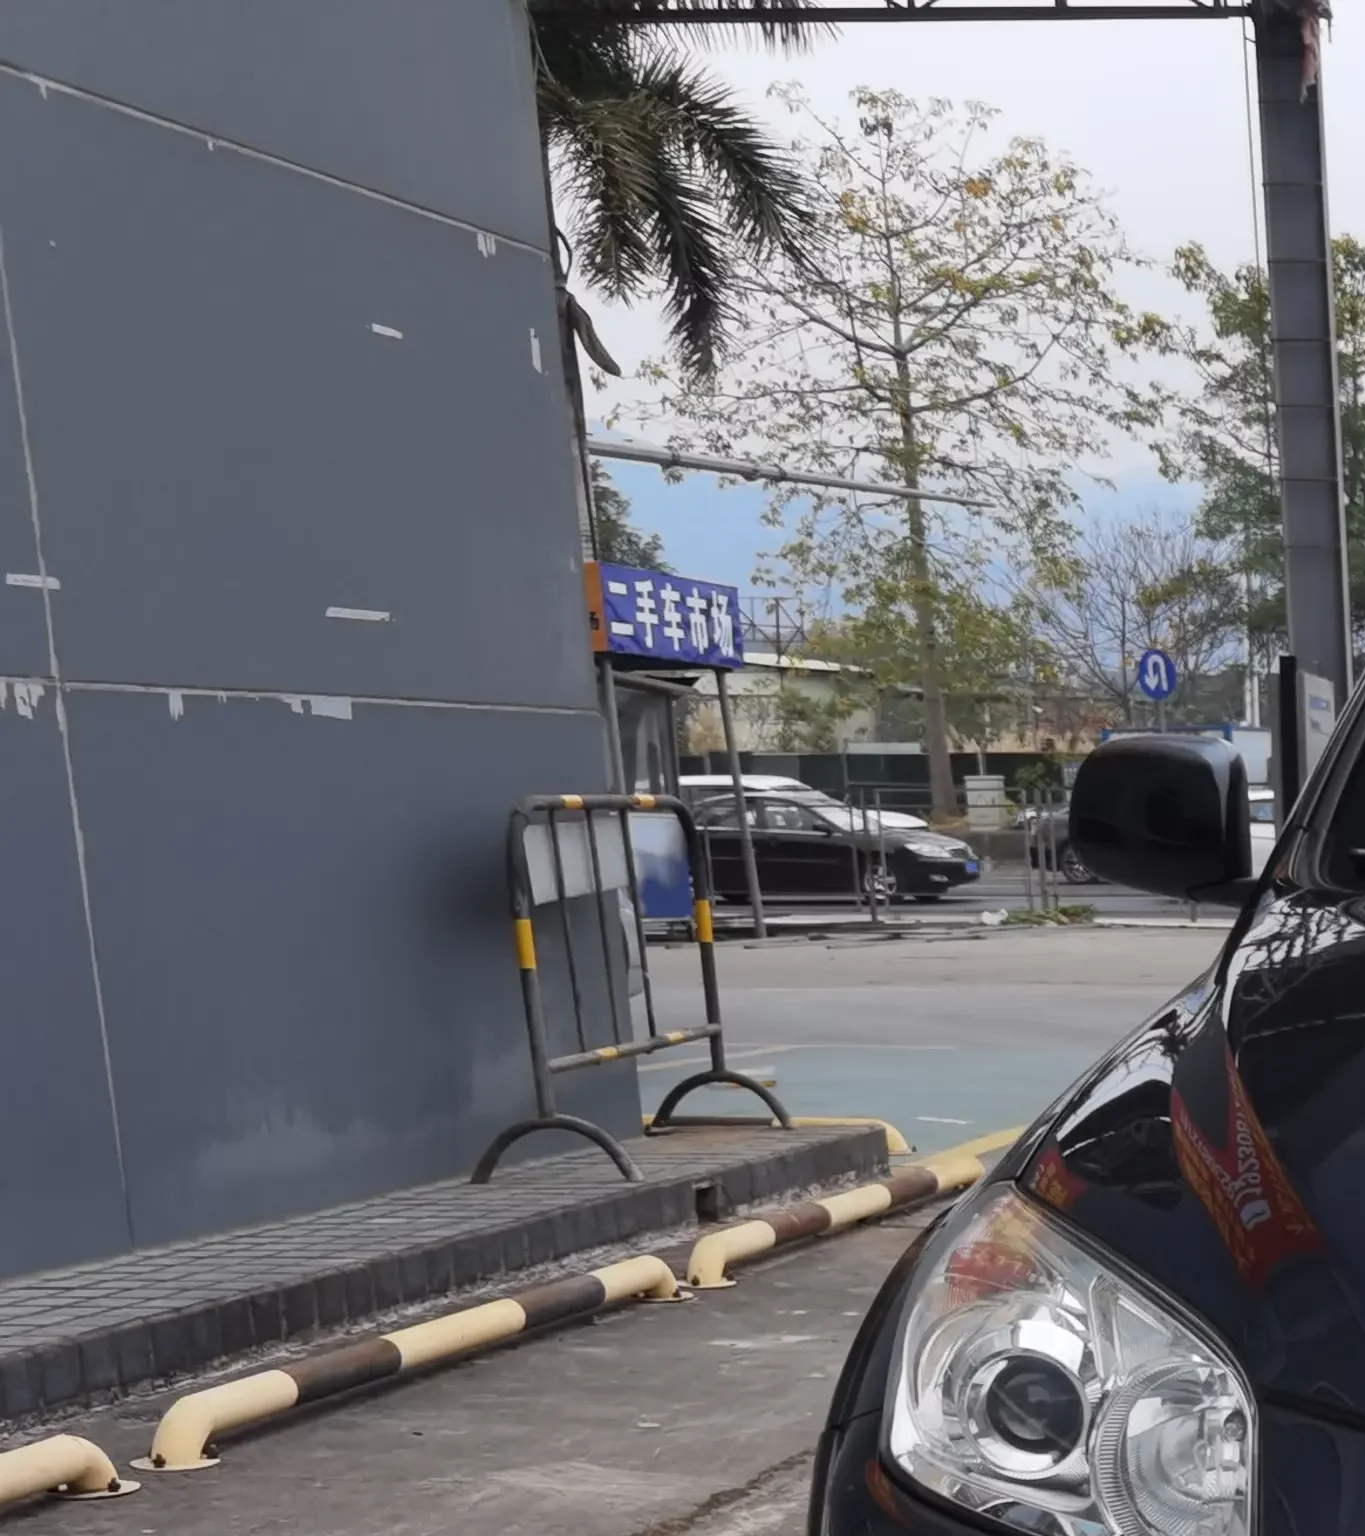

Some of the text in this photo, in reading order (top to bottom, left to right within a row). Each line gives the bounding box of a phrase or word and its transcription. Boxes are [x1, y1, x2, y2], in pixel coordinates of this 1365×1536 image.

[608, 579, 734, 656] 二手车市场
